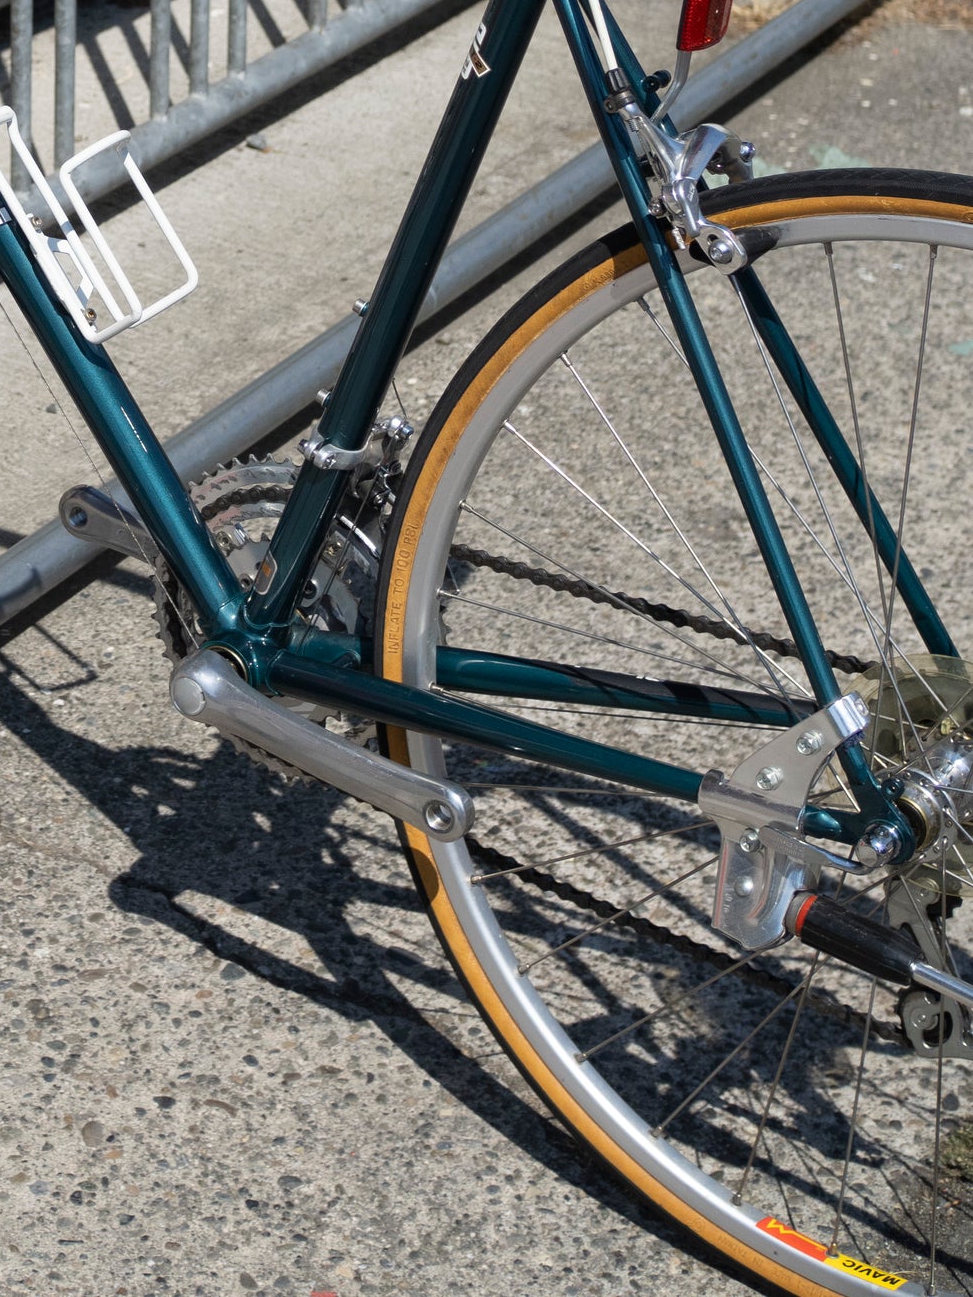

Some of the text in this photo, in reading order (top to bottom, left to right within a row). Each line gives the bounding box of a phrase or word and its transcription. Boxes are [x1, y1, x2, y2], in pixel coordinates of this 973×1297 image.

[396, 549, 411, 573] 100
[393, 578, 405, 596] TO
[388, 601, 401, 654] INFLATE
[842, 1259, 901, 1286] MAVIC
